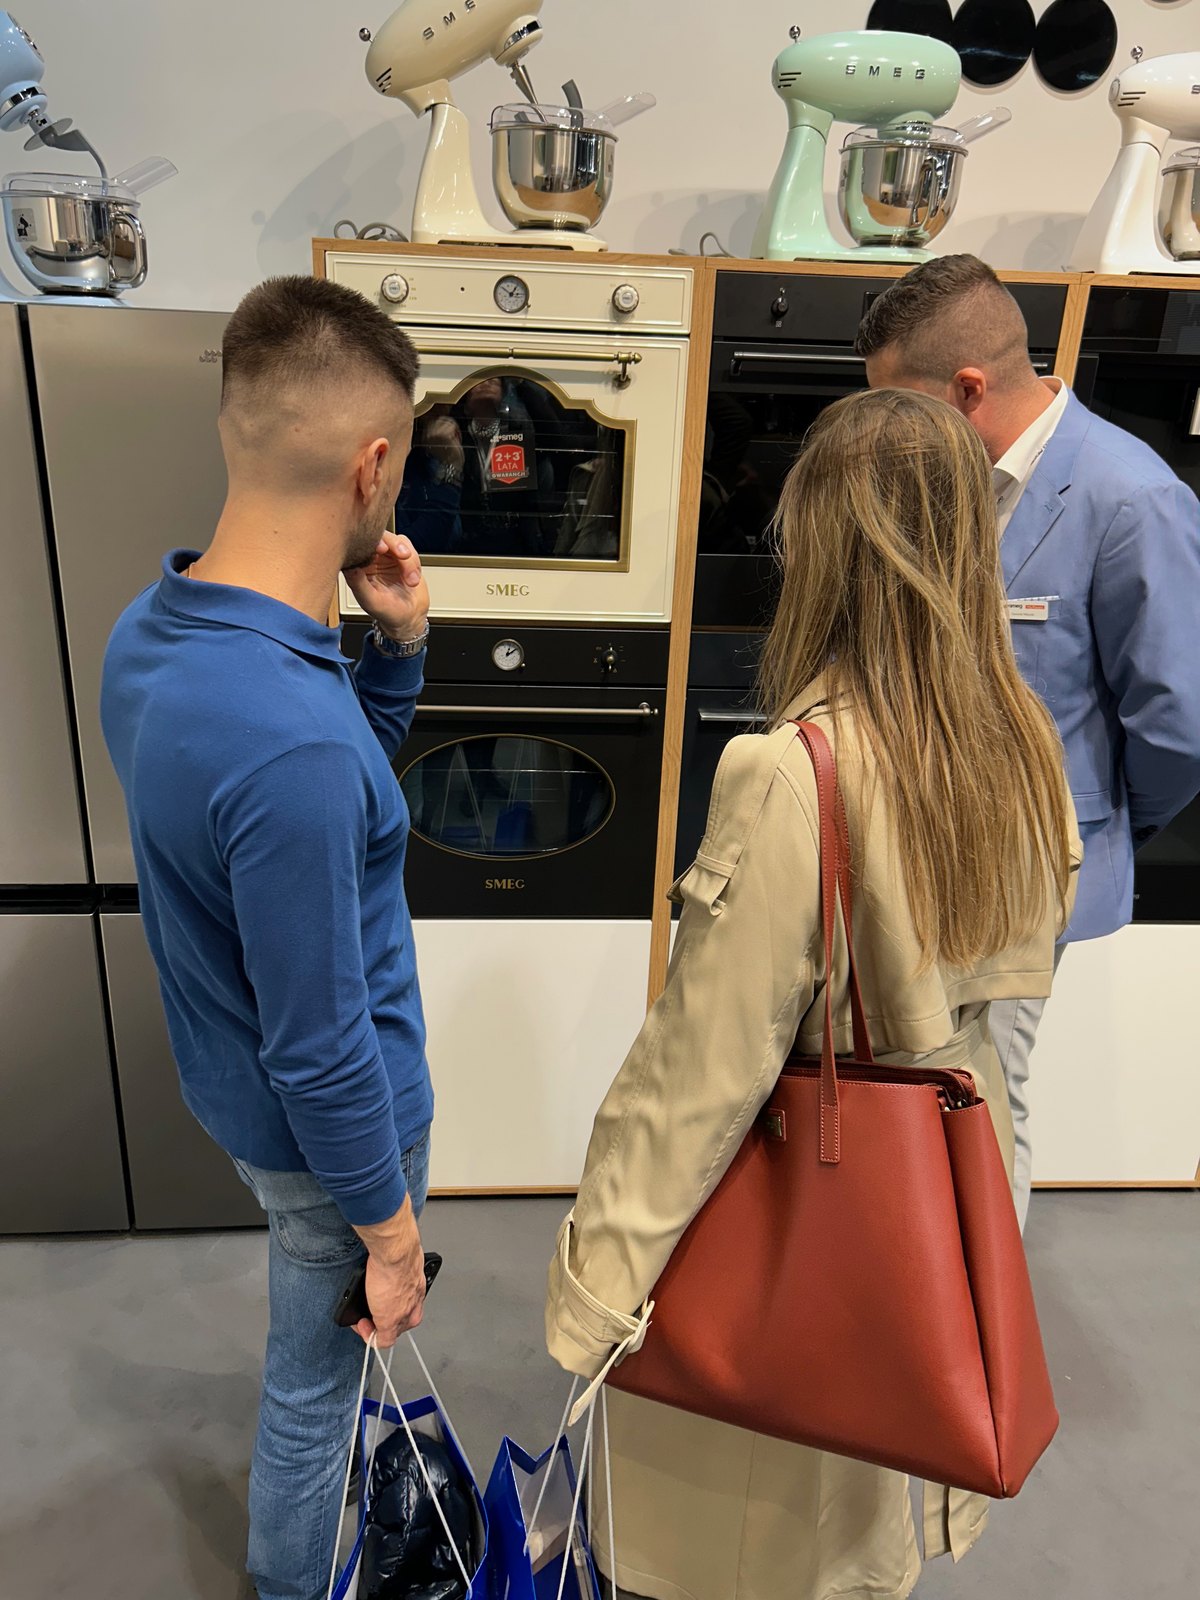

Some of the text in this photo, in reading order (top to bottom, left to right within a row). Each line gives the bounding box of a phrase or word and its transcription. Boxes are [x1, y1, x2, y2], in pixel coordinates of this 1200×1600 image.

[422, 0, 476, 40] SME
[845, 64, 926, 80] SMEG
[501, 433, 524, 442] smeg
[497, 462, 519, 471] LATA
[486, 583, 530, 597] SMEG
[485, 878, 525, 890] SMEG
